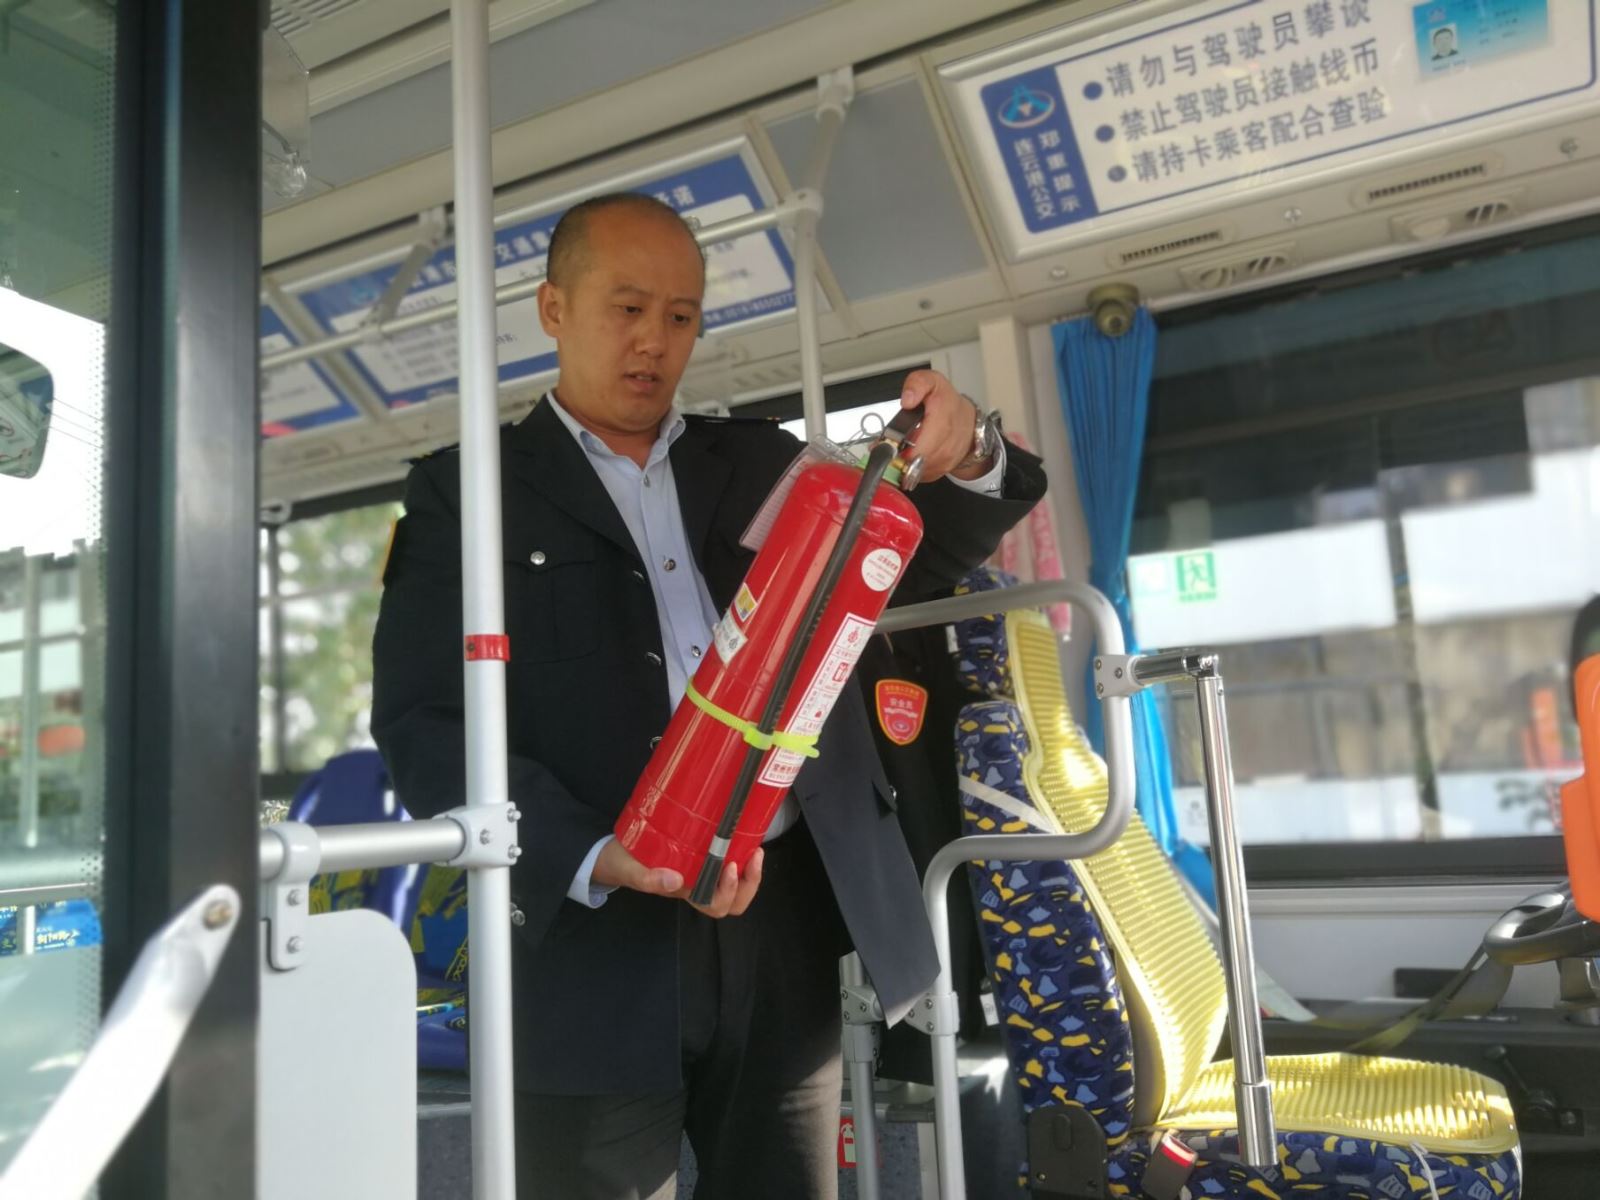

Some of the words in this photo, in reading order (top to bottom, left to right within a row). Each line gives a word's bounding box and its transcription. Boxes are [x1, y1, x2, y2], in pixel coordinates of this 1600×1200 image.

[1105, 0, 1372, 98] 请勿与驾驶员攀谈
[1119, 37, 1380, 142] 禁止驾驶员接触钱币
[1013, 138, 1057, 220] 连云港公交
[1038, 130, 1080, 213] 郑重提示
[1131, 86, 1388, 184] 请持卡乘客配合查验
